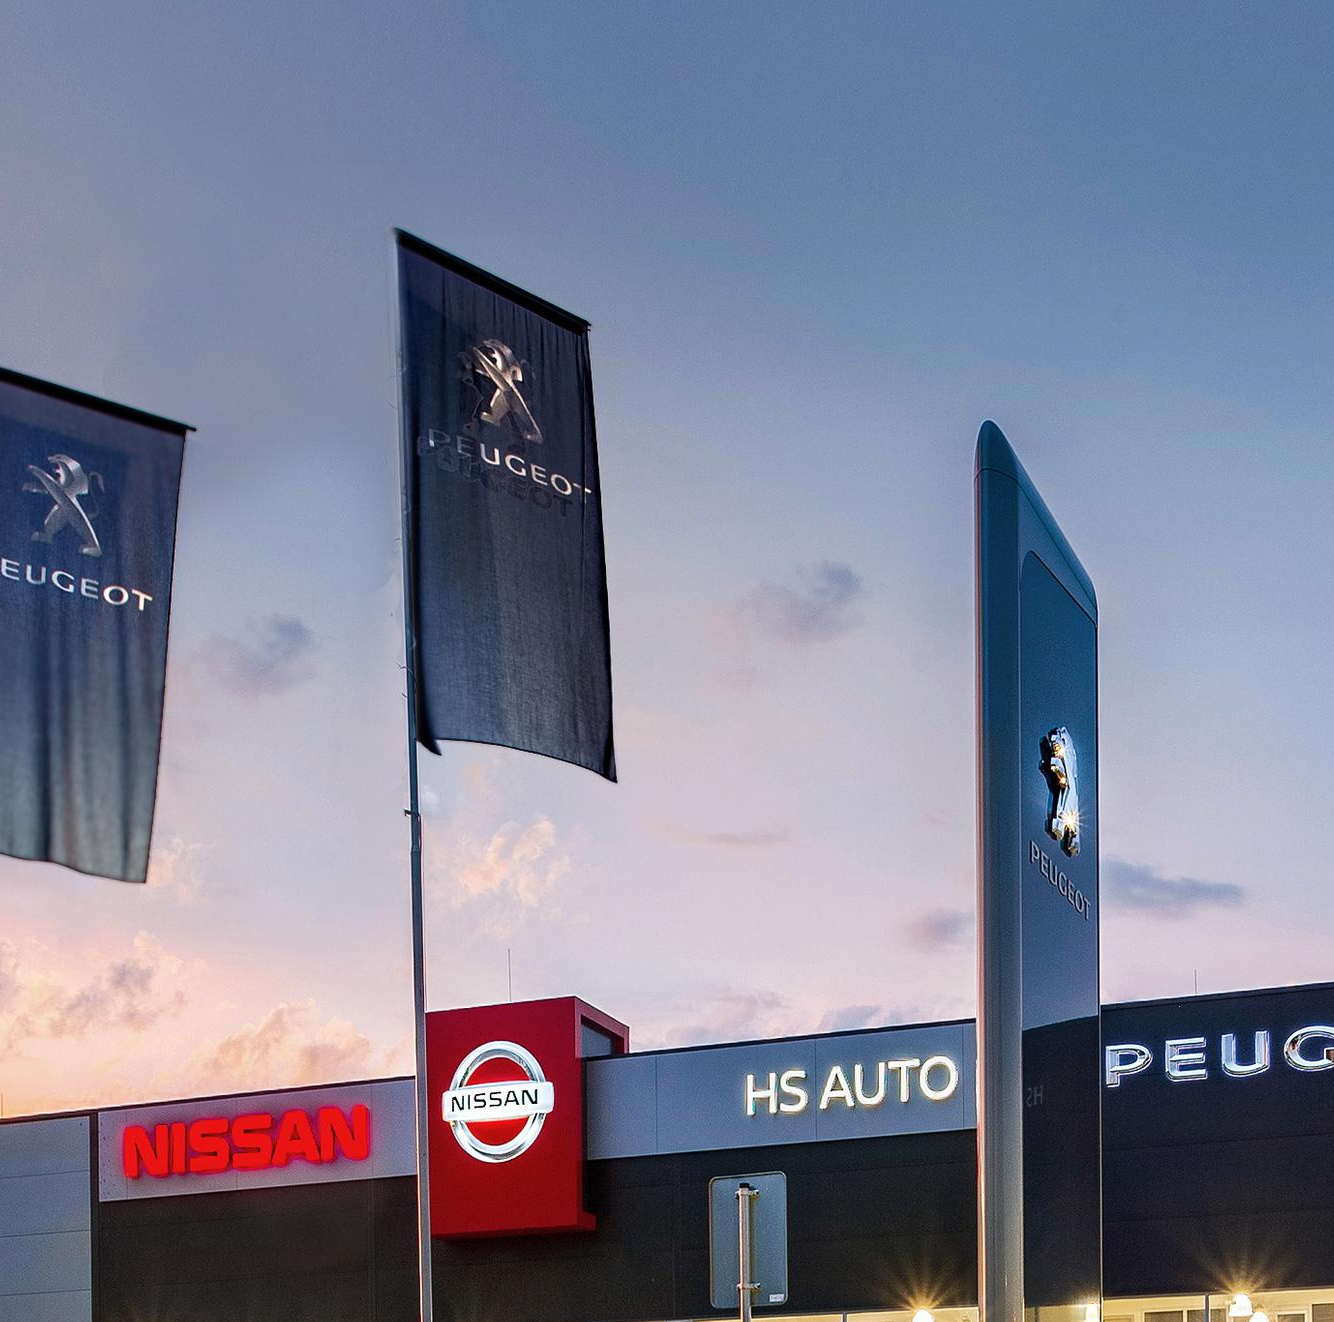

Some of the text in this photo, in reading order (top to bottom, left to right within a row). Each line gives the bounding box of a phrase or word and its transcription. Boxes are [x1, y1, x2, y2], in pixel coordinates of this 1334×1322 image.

[428, 427, 593, 505] PEUGEOT
[1029, 840, 1091, 921] PEUGEOT
[451, 1088, 539, 1113] NISSAN
[745, 1055, 960, 1117] HS AUTO
[122, 1104, 370, 1179] NISSAN
